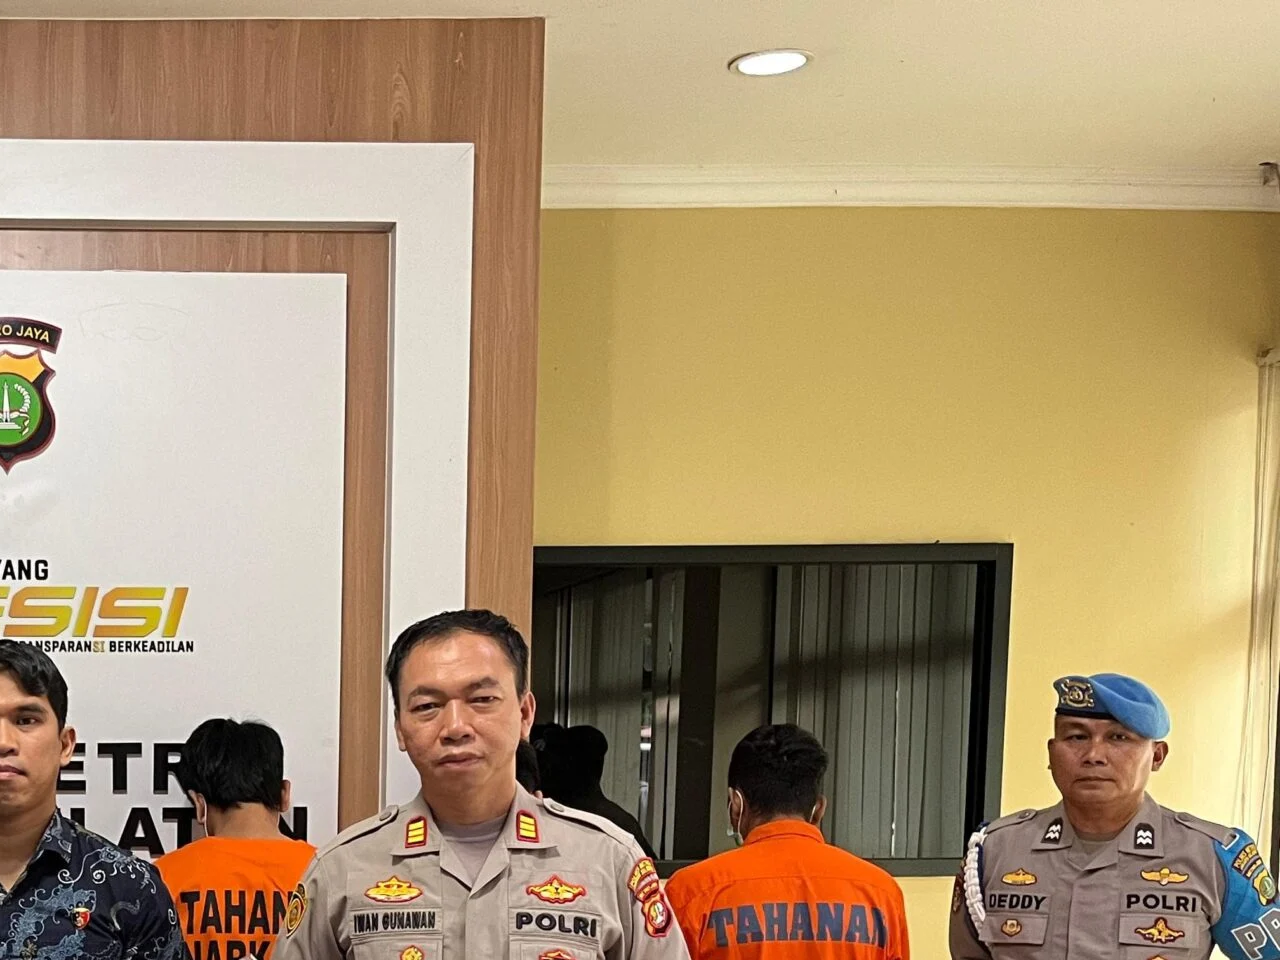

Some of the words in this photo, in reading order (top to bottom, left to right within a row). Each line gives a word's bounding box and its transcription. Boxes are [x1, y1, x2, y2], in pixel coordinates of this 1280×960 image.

[16, 325, 50, 343] JAYA
[109, 640, 195, 653] BERKEADILAN
[56, 742, 189, 795] ETR
[180, 890, 295, 934] TAHAN
[989, 894, 1047, 910] DEDDY
[1126, 893, 1197, 913] POLRI
[354, 913, 379, 933] IWAN
[382, 911, 436, 930] GUNAWAN
[516, 912, 597, 938] POLRI
